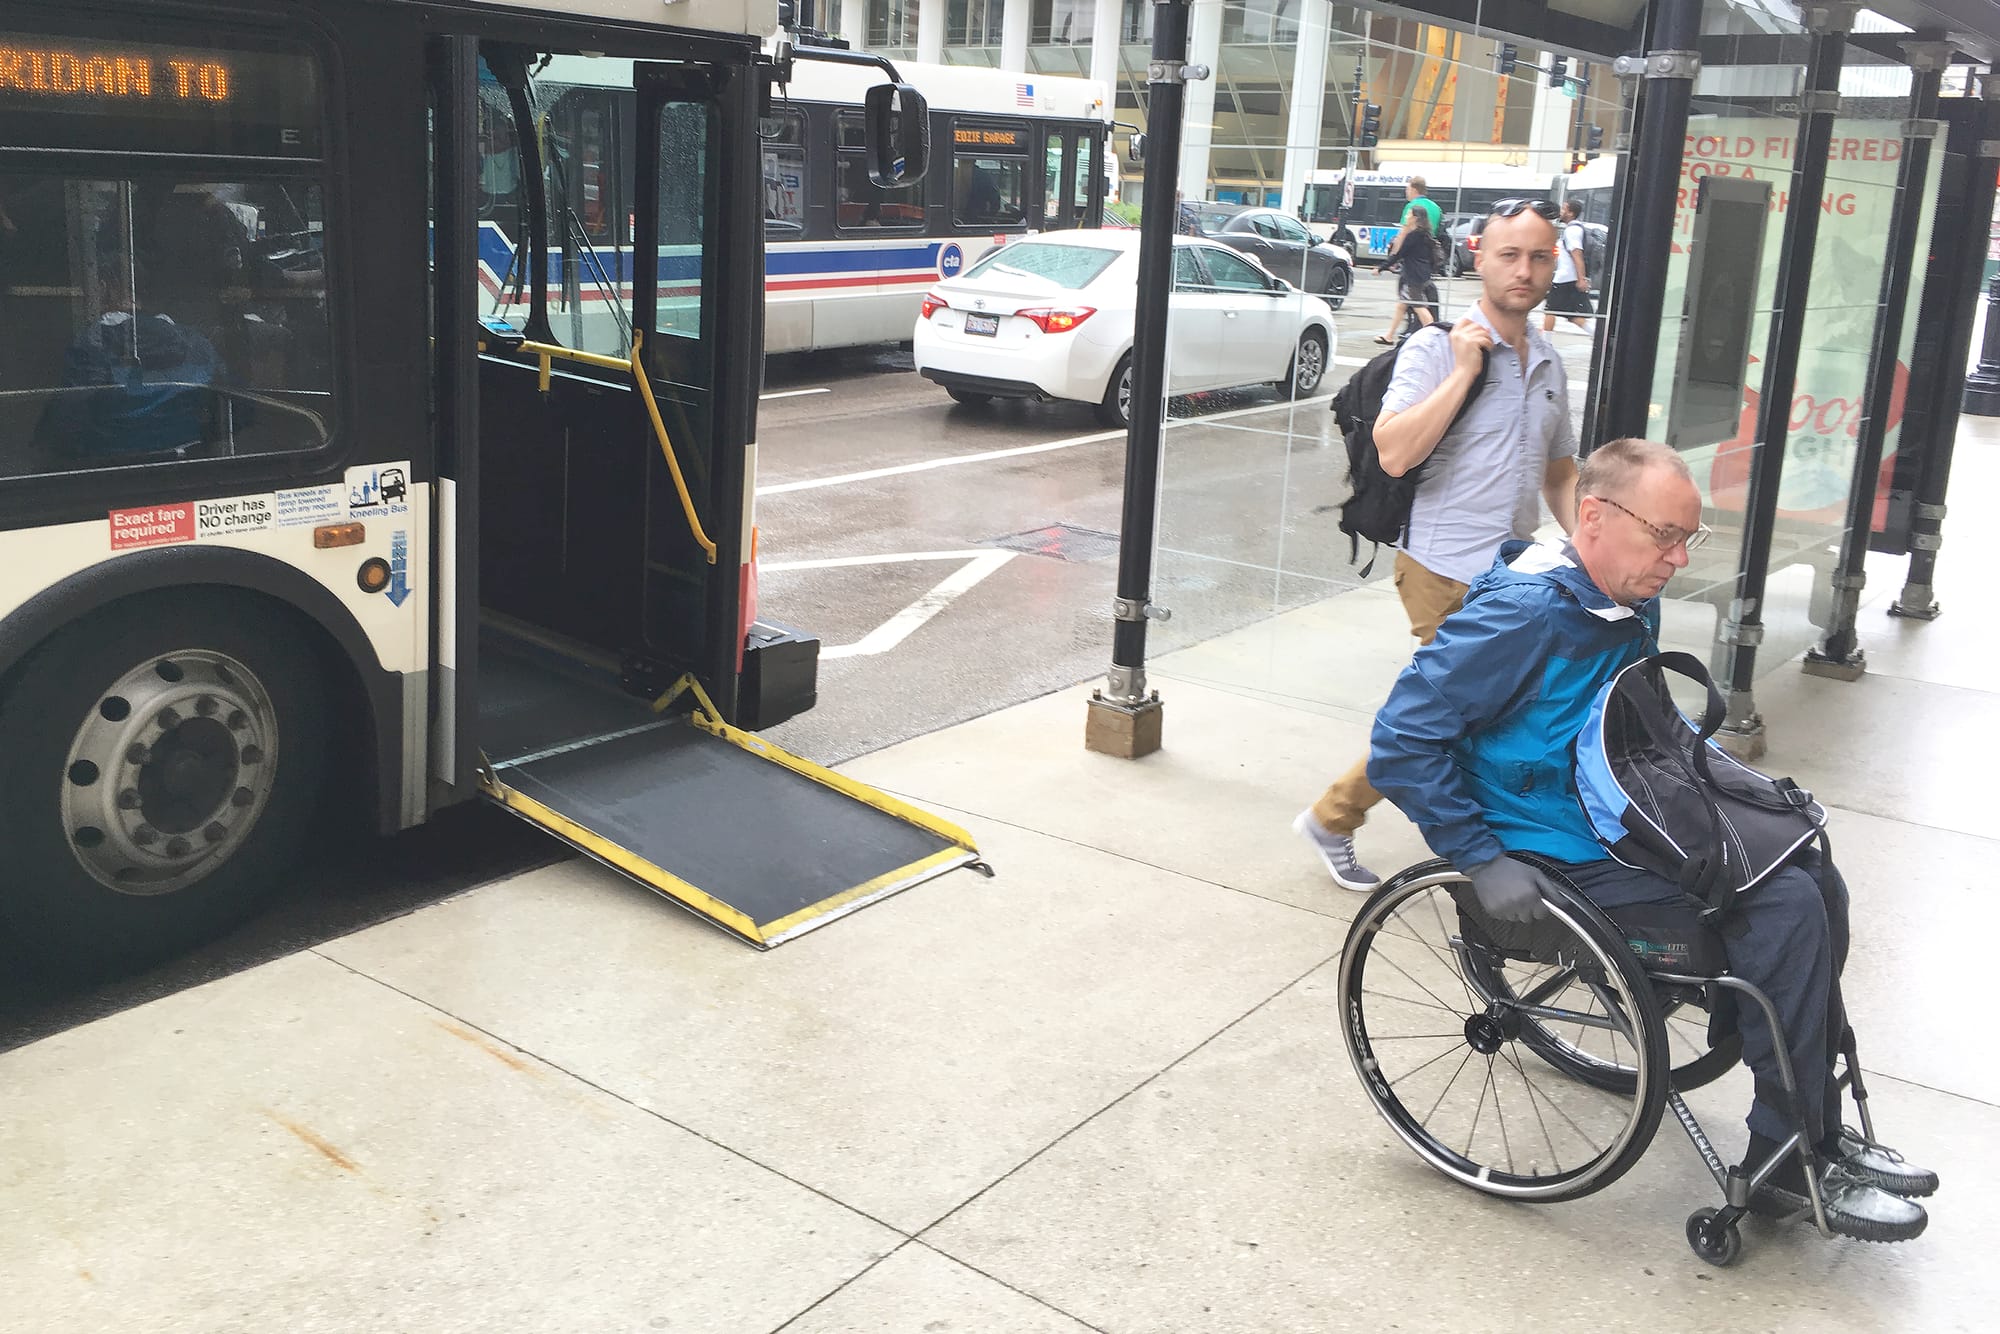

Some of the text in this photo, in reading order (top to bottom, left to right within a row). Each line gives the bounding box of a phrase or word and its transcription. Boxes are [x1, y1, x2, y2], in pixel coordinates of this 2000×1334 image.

[168, 60, 229, 101] TO
[1763, 136, 1903, 162] FIERED
[943, 254, 960, 268] cta
[199, 500, 266, 516] Driver has
[349, 507, 389, 519] Kneeling
[391, 504, 409, 513] Bus
[113, 508, 186, 527] Exact fare
[199, 515, 221, 529] NO
[224, 511, 272, 525] change
[114, 520, 176, 540] required
